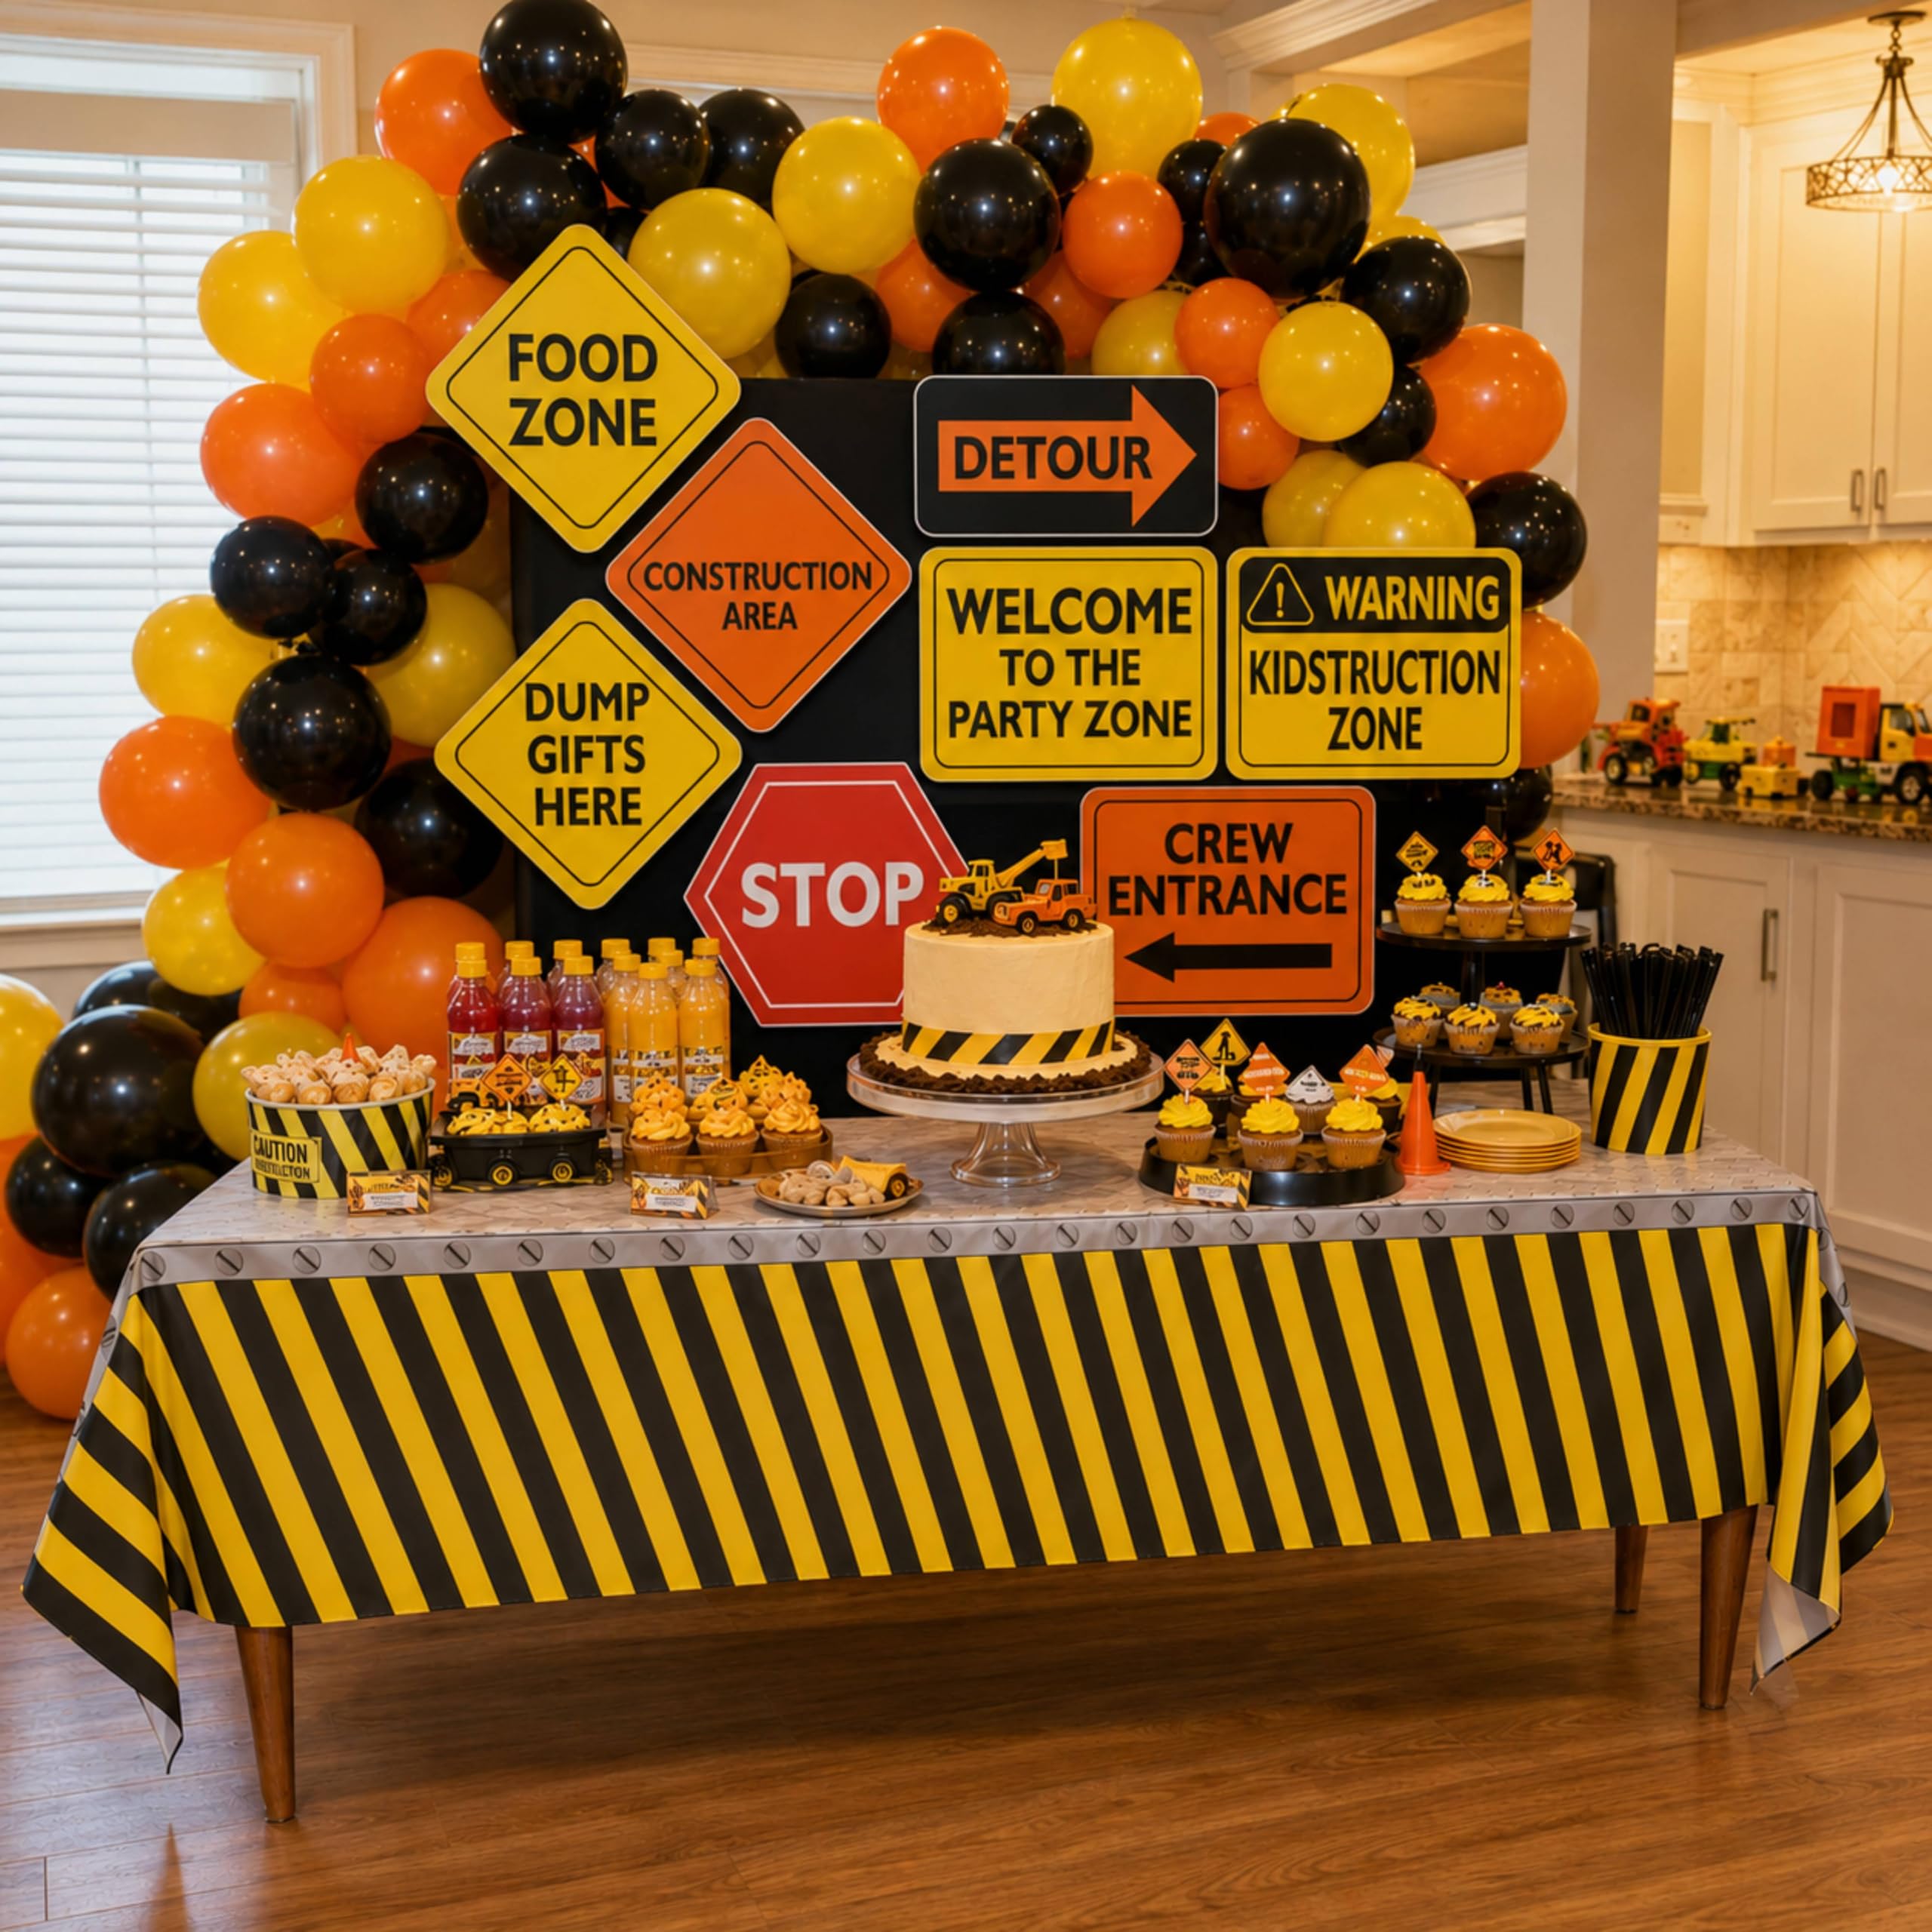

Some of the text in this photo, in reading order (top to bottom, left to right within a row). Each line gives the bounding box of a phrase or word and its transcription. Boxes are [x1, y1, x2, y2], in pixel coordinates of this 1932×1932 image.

[509, 334, 657, 382] FOOD
[509, 398, 657, 446] ZONE
[955, 436, 1152, 479] DETOUR
[643, 561, 872, 591] CONSTRUCTION
[722, 602, 797, 630] AREA
[946, 588, 1191, 634] WELCOME
[1325, 576, 1499, 620] WARNING
[1000, 649, 1140, 686] TO THE
[1251, 650, 1500, 694] KIDSTRUCTION
[525, 683, 649, 721] DUMP
[949, 700, 1191, 737] PARTY ZONE
[1328, 706, 1422, 750] ZONE
[528, 735, 645, 774] GIFTS
[536, 787, 641, 826] HERE
[1165, 823, 1293, 864] CREW
[742, 862, 924, 928] STOP
[1109, 874, 1346, 915] ENTRANCE
[253, 1134, 307, 1164] CAUTION
